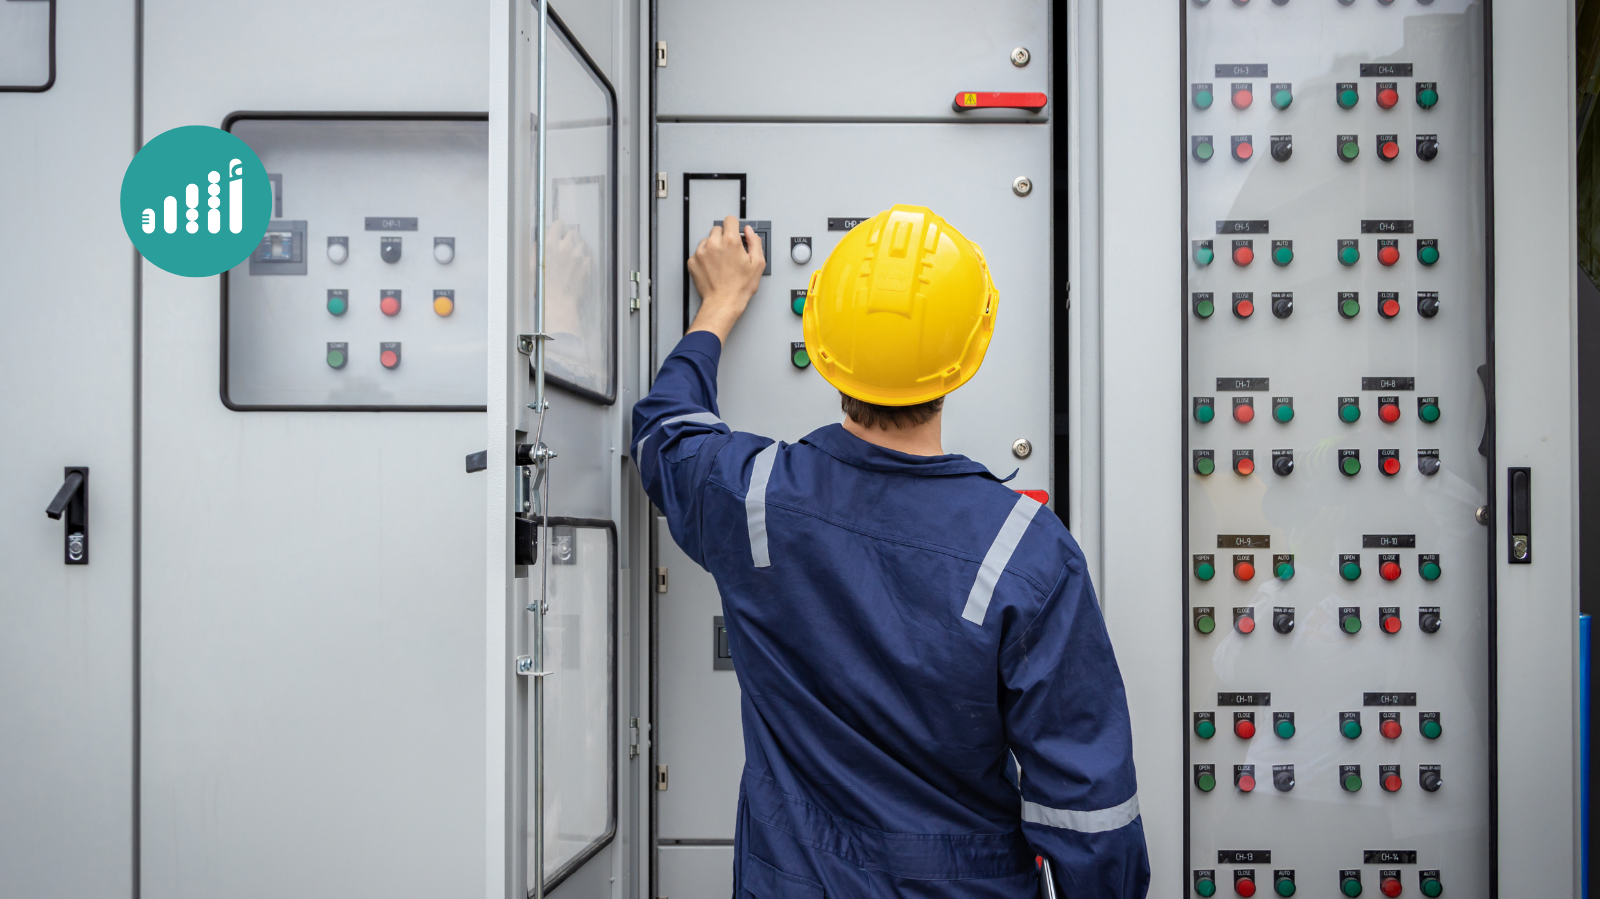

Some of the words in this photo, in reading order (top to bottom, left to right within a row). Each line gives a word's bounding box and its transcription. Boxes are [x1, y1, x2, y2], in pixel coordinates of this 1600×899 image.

[1233, 67, 1249, 75] CH-3
[1378, 65, 1394, 74] CH-4
[382, 220, 401, 228] CHP-1
[1234, 223, 1250, 231] CH-5
[1380, 223, 1395, 231] CH-6
[1235, 380, 1250, 388] CH-7
[1381, 380, 1396, 388] CH-8
[1236, 537, 1251, 546] CH-9
[1381, 537, 1397, 546] CH-10
[1236, 695, 1252, 703] CH-11
[1381, 695, 1398, 703] CH-12
[1236, 853, 1253, 861] CH-13
[1381, 853, 1399, 861] CH-14
